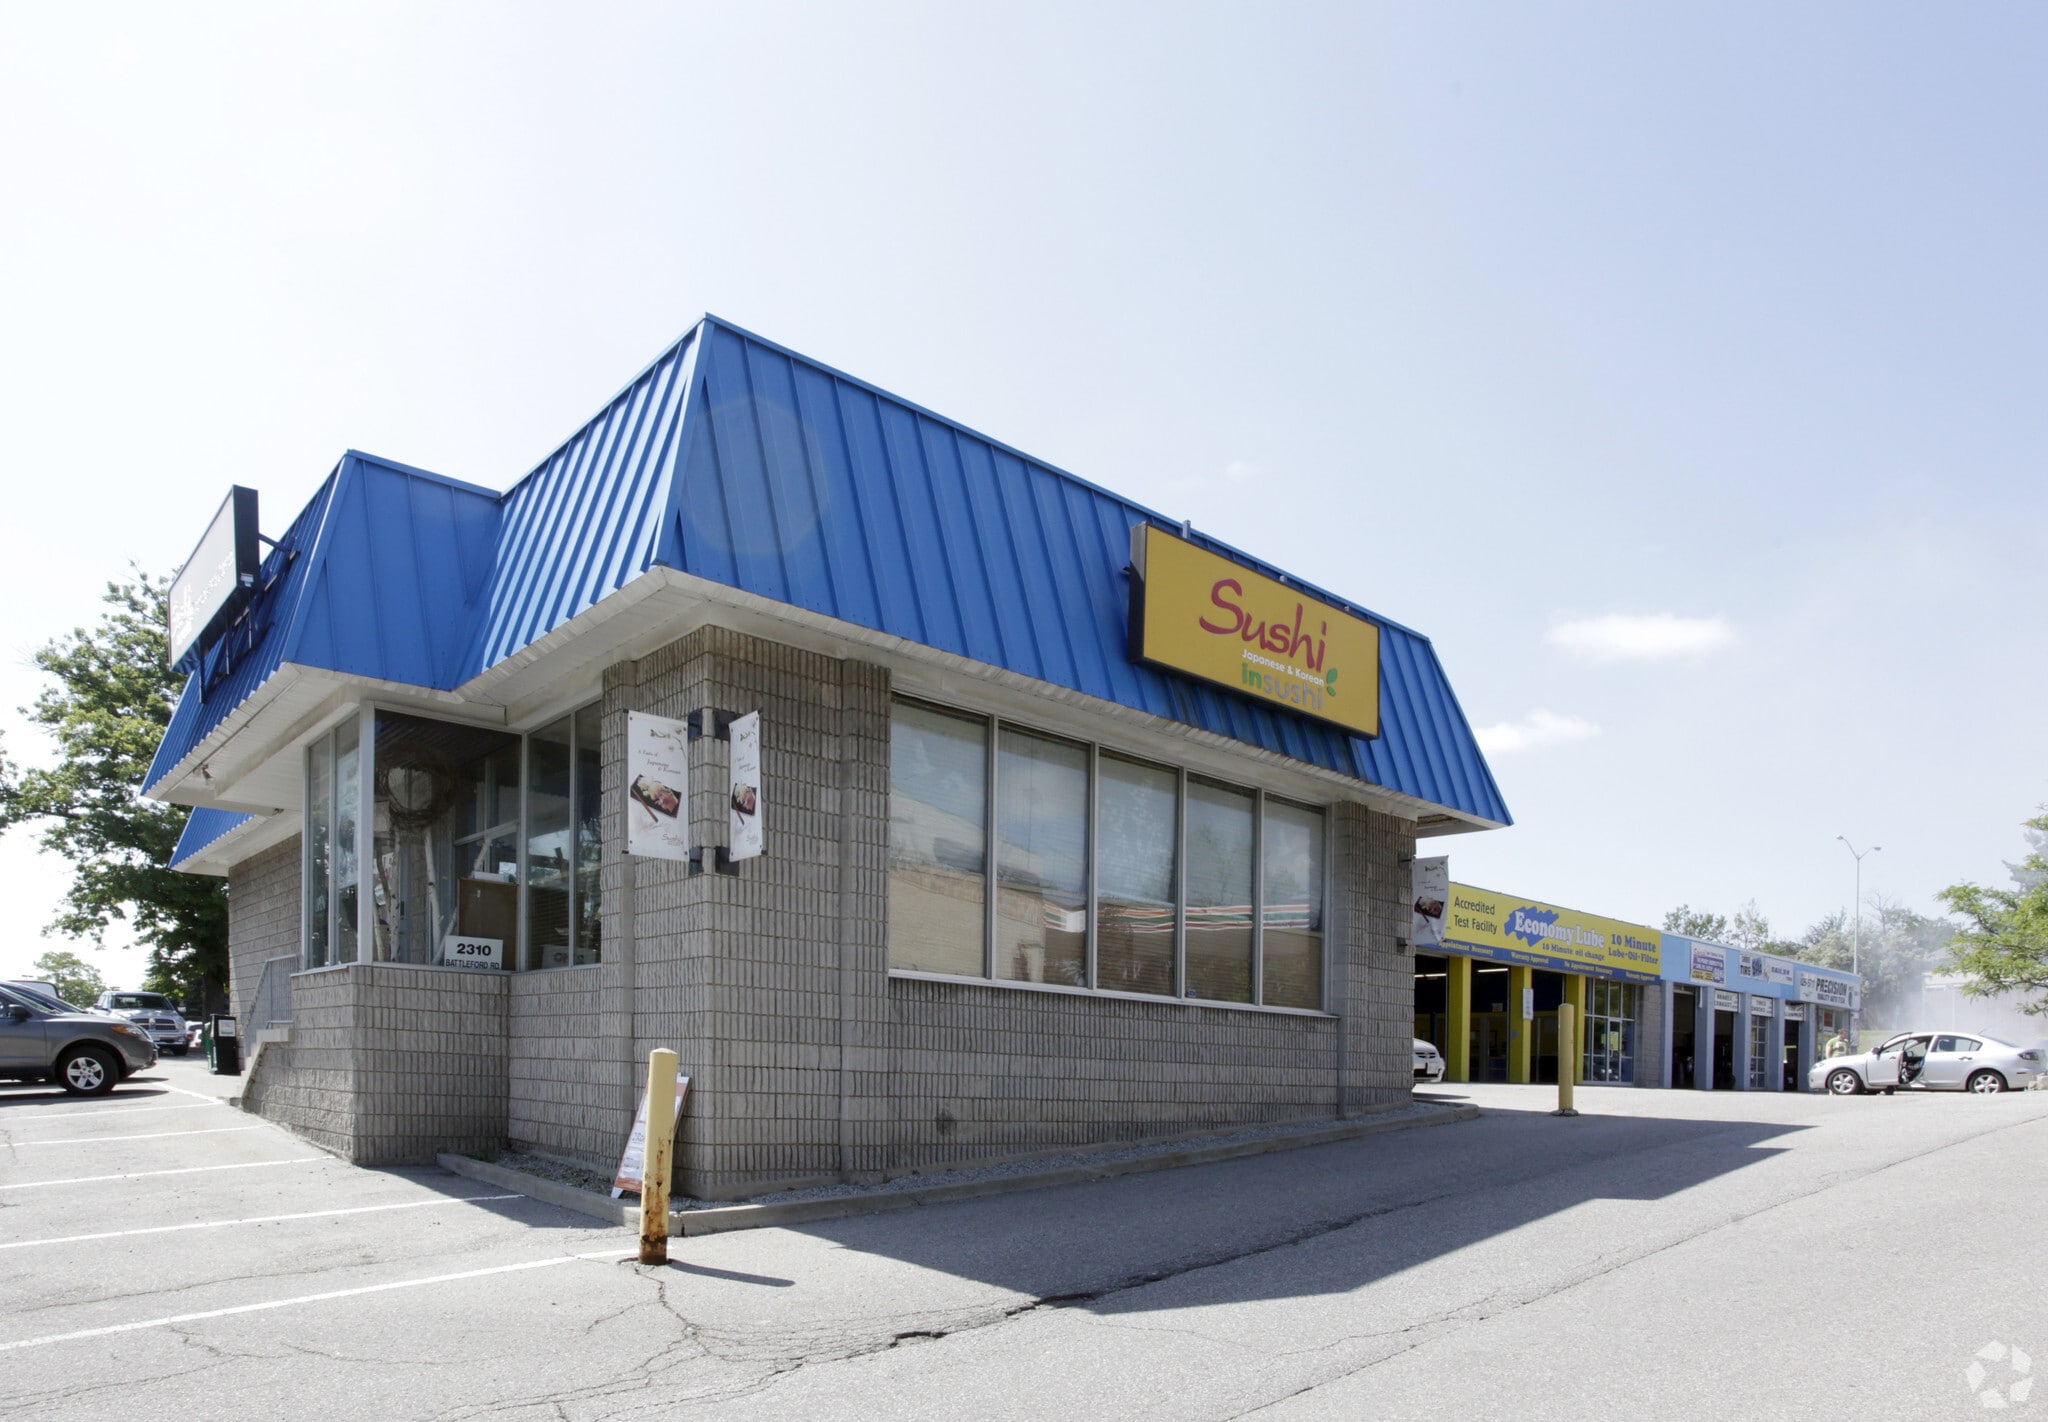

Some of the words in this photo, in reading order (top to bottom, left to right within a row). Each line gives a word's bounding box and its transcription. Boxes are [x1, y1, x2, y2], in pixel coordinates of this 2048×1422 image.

[1199, 578, 1327, 673] Sushi
[1242, 649, 1285, 672] Japanese
[1287, 665, 1293, 675] &
[1295, 667, 1324, 686] Korean
[1242, 662, 1324, 711] insushi
[1454, 896, 1495, 915] Accredited
[1454, 914, 1469, 929] Test
[1472, 918, 1497, 935] Facility
[1515, 911, 1574, 945] Economy
[1576, 926, 1605, 948] Lube
[457, 943, 492, 956] 2310
[1543, 943, 1550, 951] 10
[1552, 944, 1573, 955] Minute
[1585, 951, 1605, 962] change
[1612, 934, 1622, 946] 10
[1625, 935, 1656, 953] Minute
[445, 958, 489, 969] BATTLEFORD
[1816, 978, 1848, 996] PRECISION
